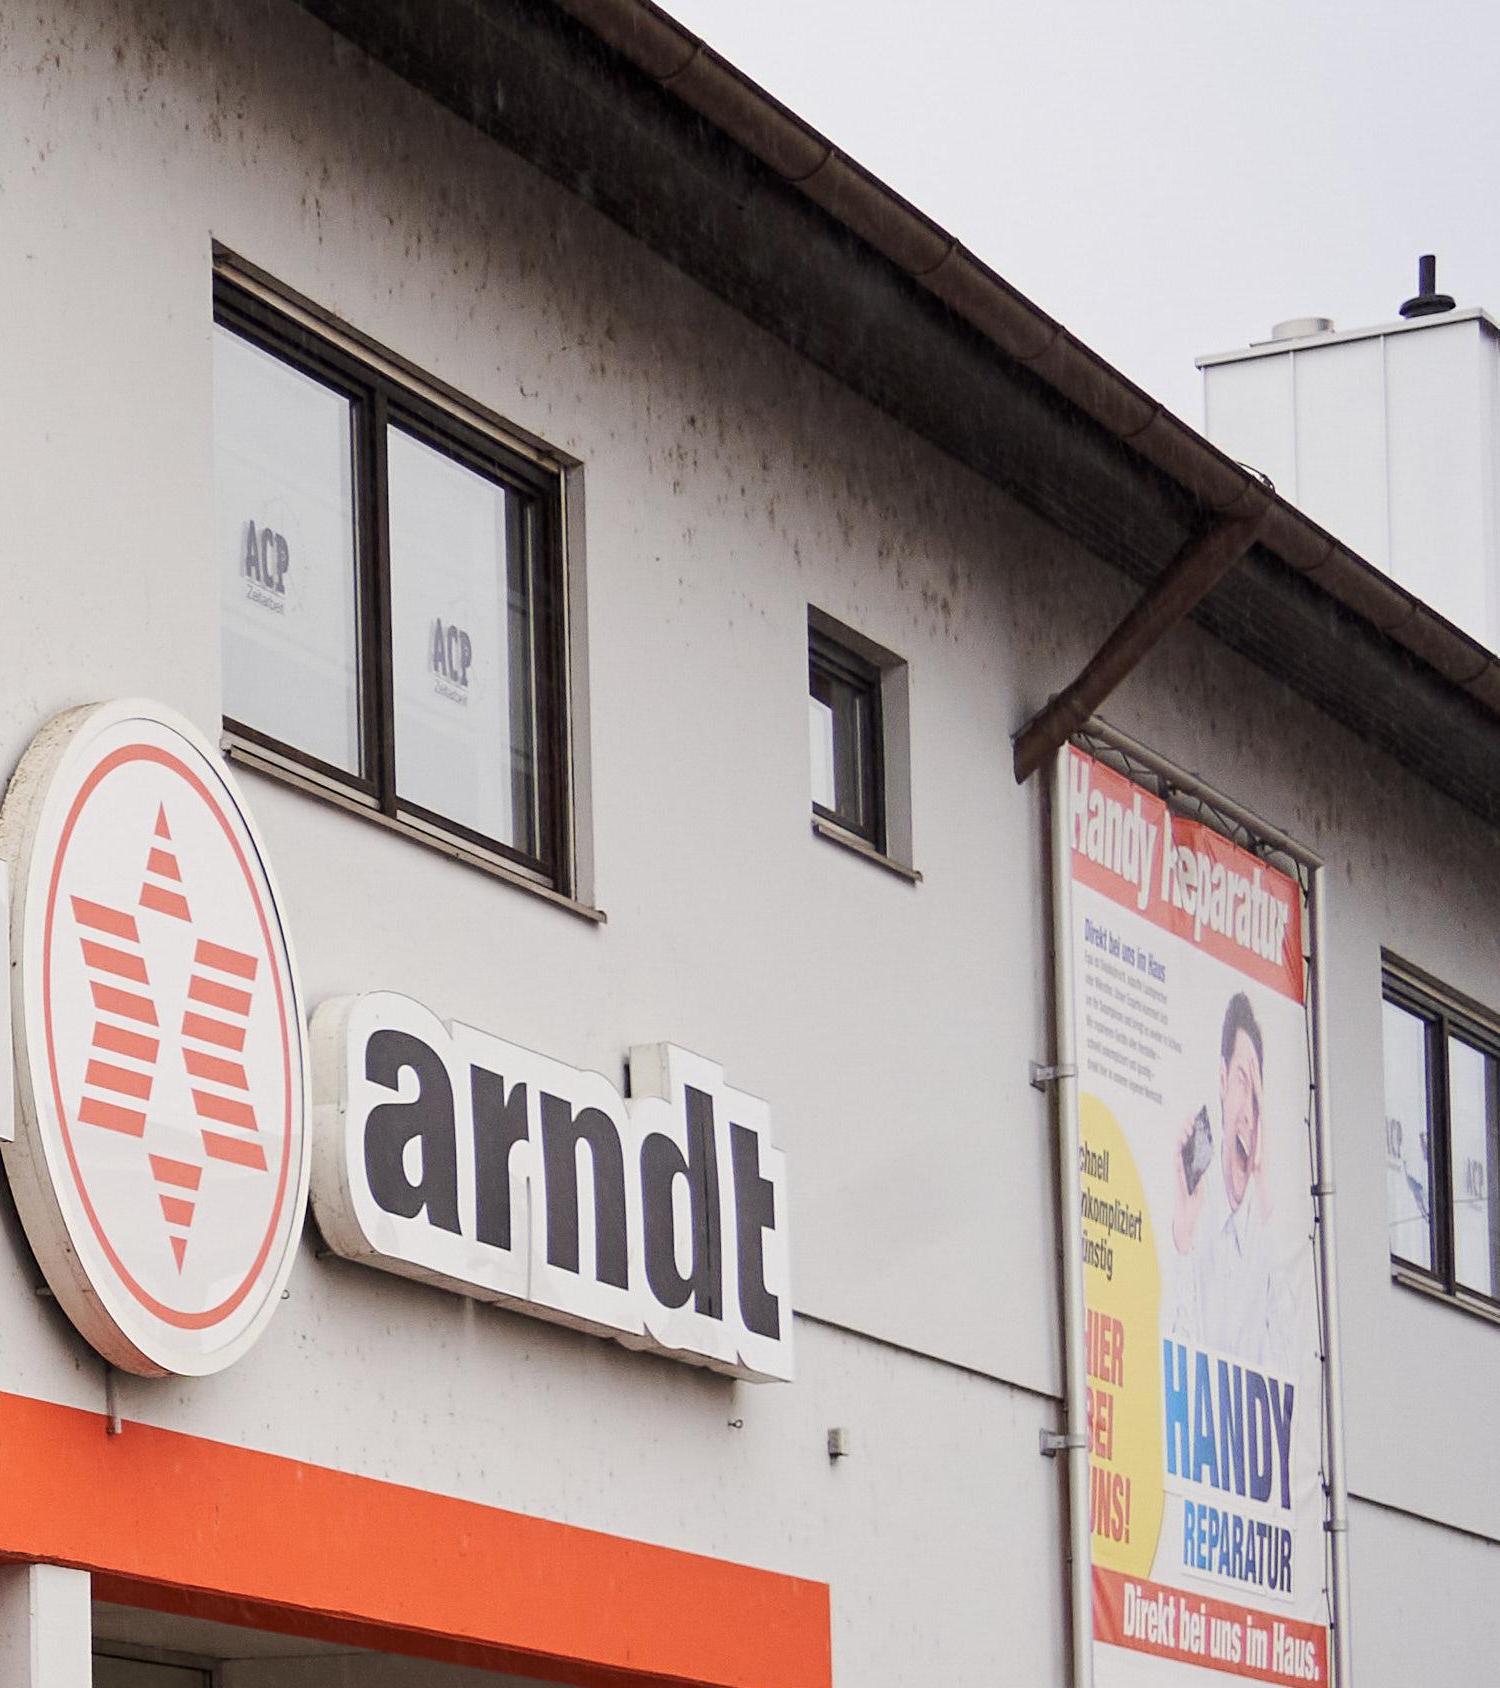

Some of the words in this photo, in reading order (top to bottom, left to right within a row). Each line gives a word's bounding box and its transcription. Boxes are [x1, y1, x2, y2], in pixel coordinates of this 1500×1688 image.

[244, 518, 290, 595] ACP
[432, 616, 473, 688] ACP
[1068, 753, 1158, 912] Handy
[363, 1028, 781, 1343] arndt
[1079, 1140, 1110, 1183] chnell
[1080, 1186, 1143, 1242] nkompliziert
[1082, 1228, 1114, 1281] ünstig
[1163, 1337, 1295, 1511] HANDY
[1183, 1498, 1292, 1593] REPARATUR
[1122, 1581, 1176, 1648] Direkt
[1179, 1597, 1206, 1655] bei
[1209, 1617, 1242, 1664] uns
[1245, 1614, 1268, 1670] im
[1272, 1621, 1320, 1682] Haus.
